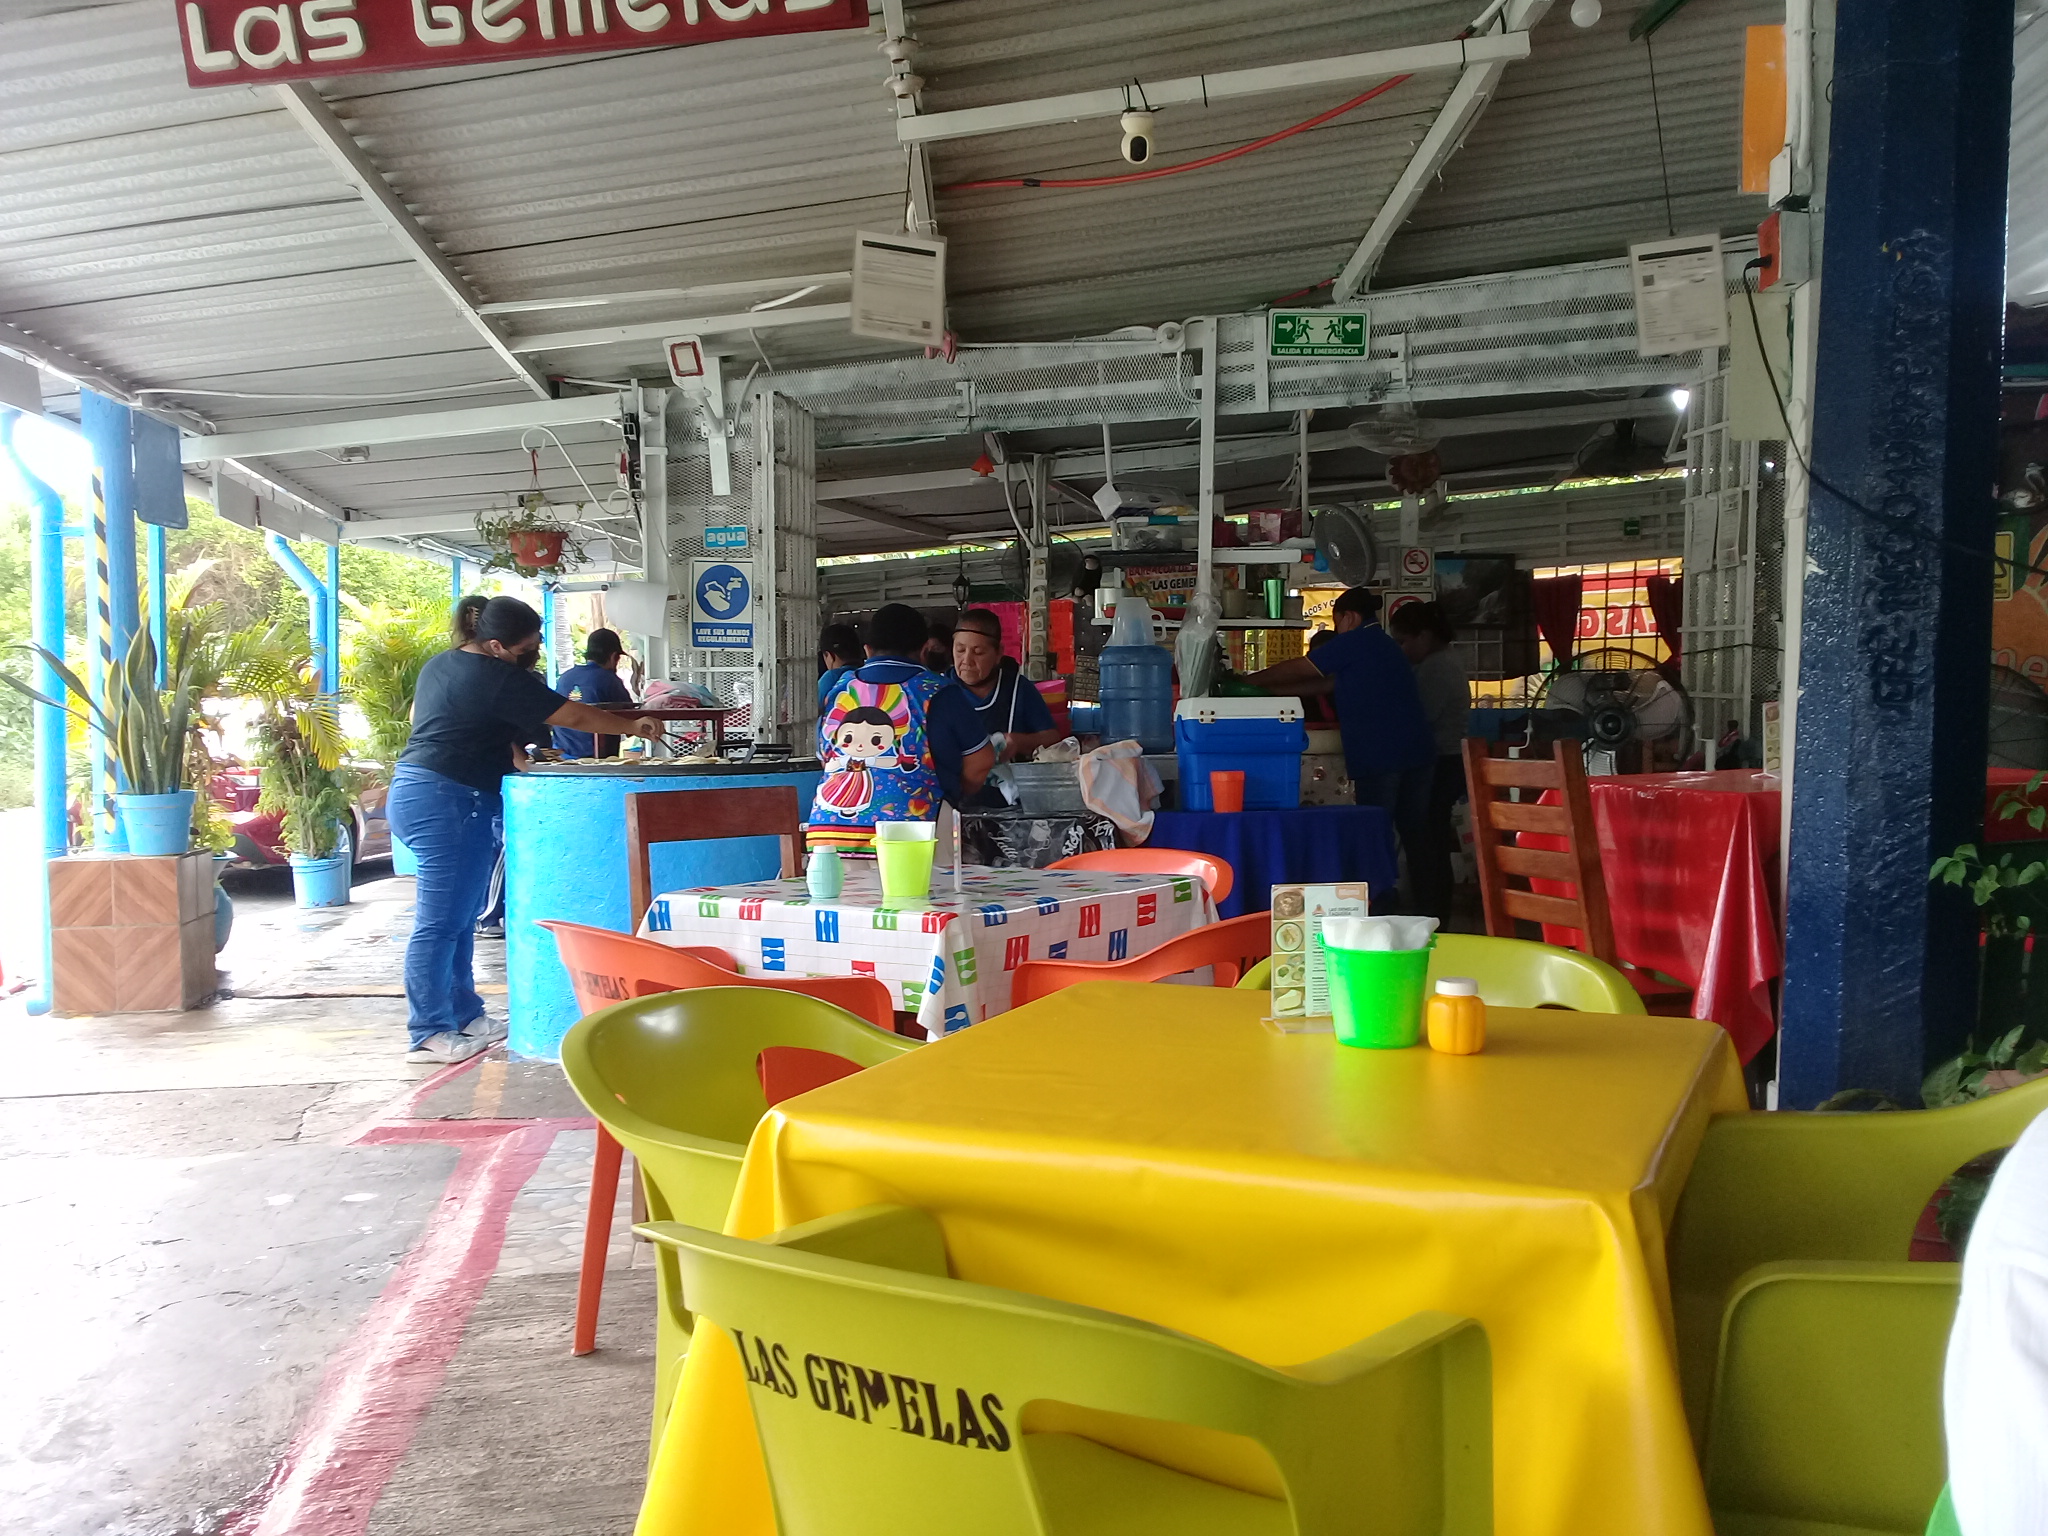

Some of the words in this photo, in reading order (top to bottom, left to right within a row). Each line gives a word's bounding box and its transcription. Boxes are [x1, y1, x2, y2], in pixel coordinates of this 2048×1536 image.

[186, 0, 366, 72] Las
[1277, 347, 1301, 355] SALIDA
[1303, 347, 1313, 355] DE
[1314, 347, 1360, 355] EMERGENCIA
[706, 530, 747, 545] agua
[1170, 577, 1197, 588] GEME
[730, 1327, 798, 1399] LAS
[804, 1353, 1011, 1451] GEMELAS
